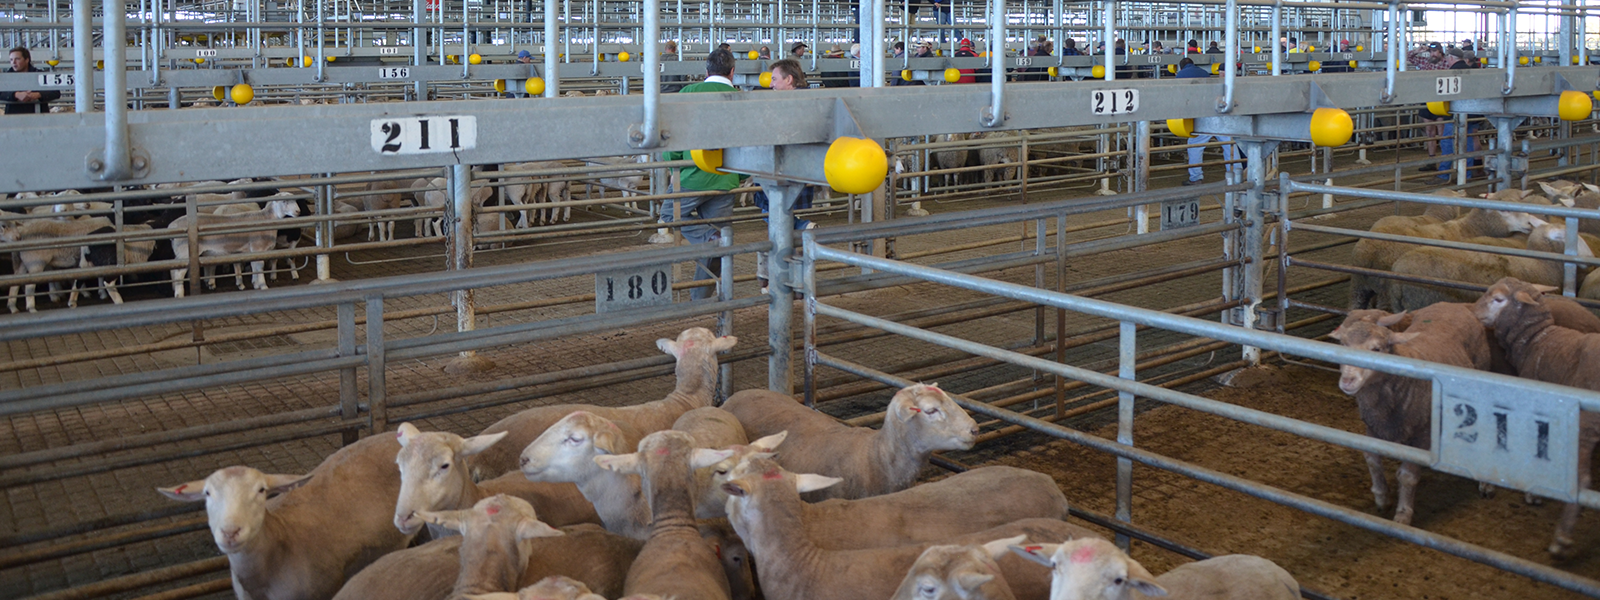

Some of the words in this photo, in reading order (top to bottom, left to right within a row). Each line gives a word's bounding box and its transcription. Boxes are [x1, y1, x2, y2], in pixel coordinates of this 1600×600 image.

[43, 74, 74, 85] 155
[382, 68, 407, 78] 156
[1437, 78, 1459, 94] 213
[1095, 90, 1134, 113] 212
[381, 118, 460, 153] 211
[1167, 202, 1199, 223] 179
[606, 270, 667, 302] 180
[1453, 403, 1551, 462] 211
